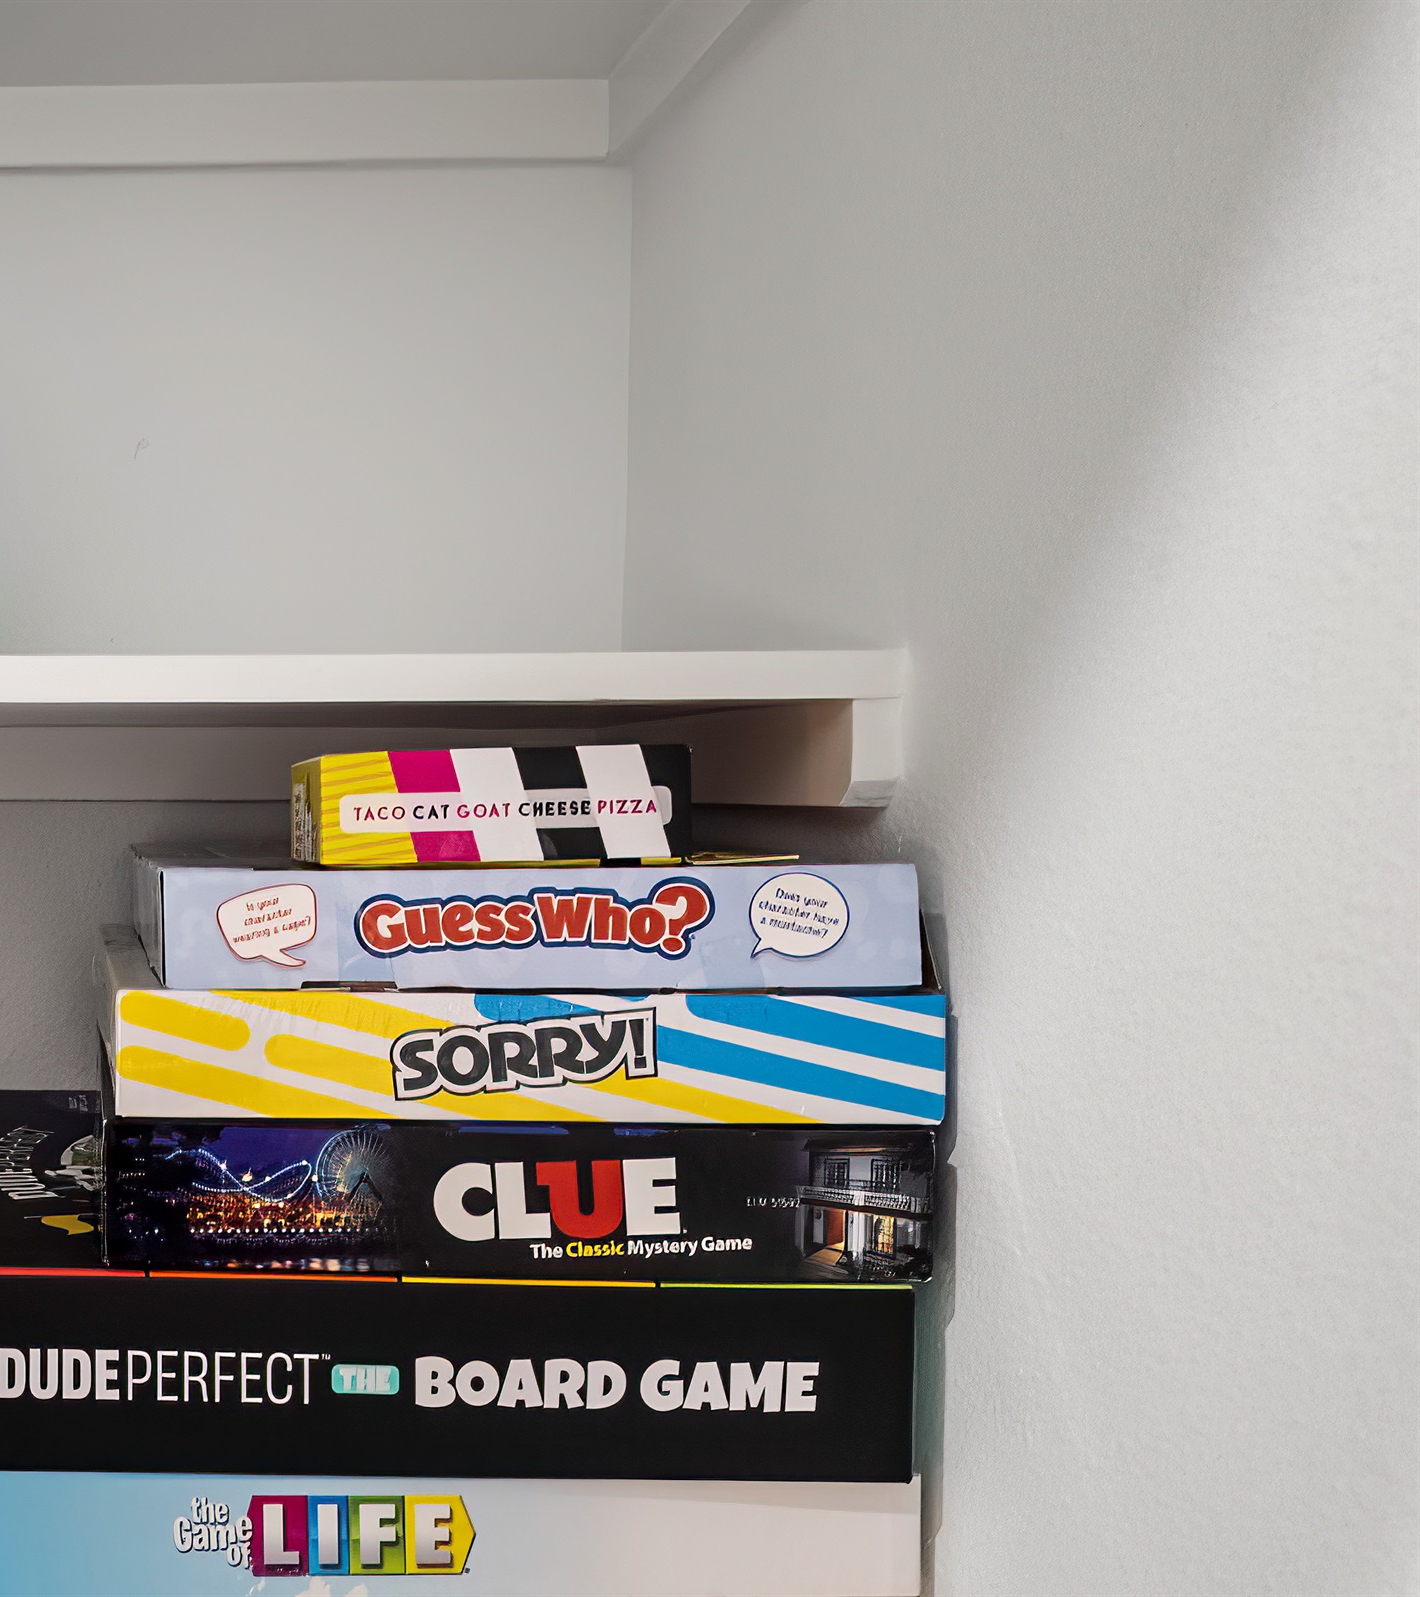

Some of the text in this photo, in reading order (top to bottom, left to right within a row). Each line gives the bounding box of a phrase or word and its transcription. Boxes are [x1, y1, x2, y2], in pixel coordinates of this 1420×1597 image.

[353, 799, 657, 821] TACO CAT GOAT CHEESE PIZZA
[399, 1017, 648, 1093] SORRY!
[433, 1157, 681, 1241] CLUE
[530, 1235, 753, 1260] The Classic Mystery Game
[338, 1366, 392, 1392] THE
[415, 1355, 628, 1411] BOARD
[640, 1358, 821, 1413] GAME
[191, 1496, 230, 1525] the
[173, 1515, 253, 1553] Game
[263, 1503, 454, 1567] LIFE
[226, 1540, 253, 1570] of
